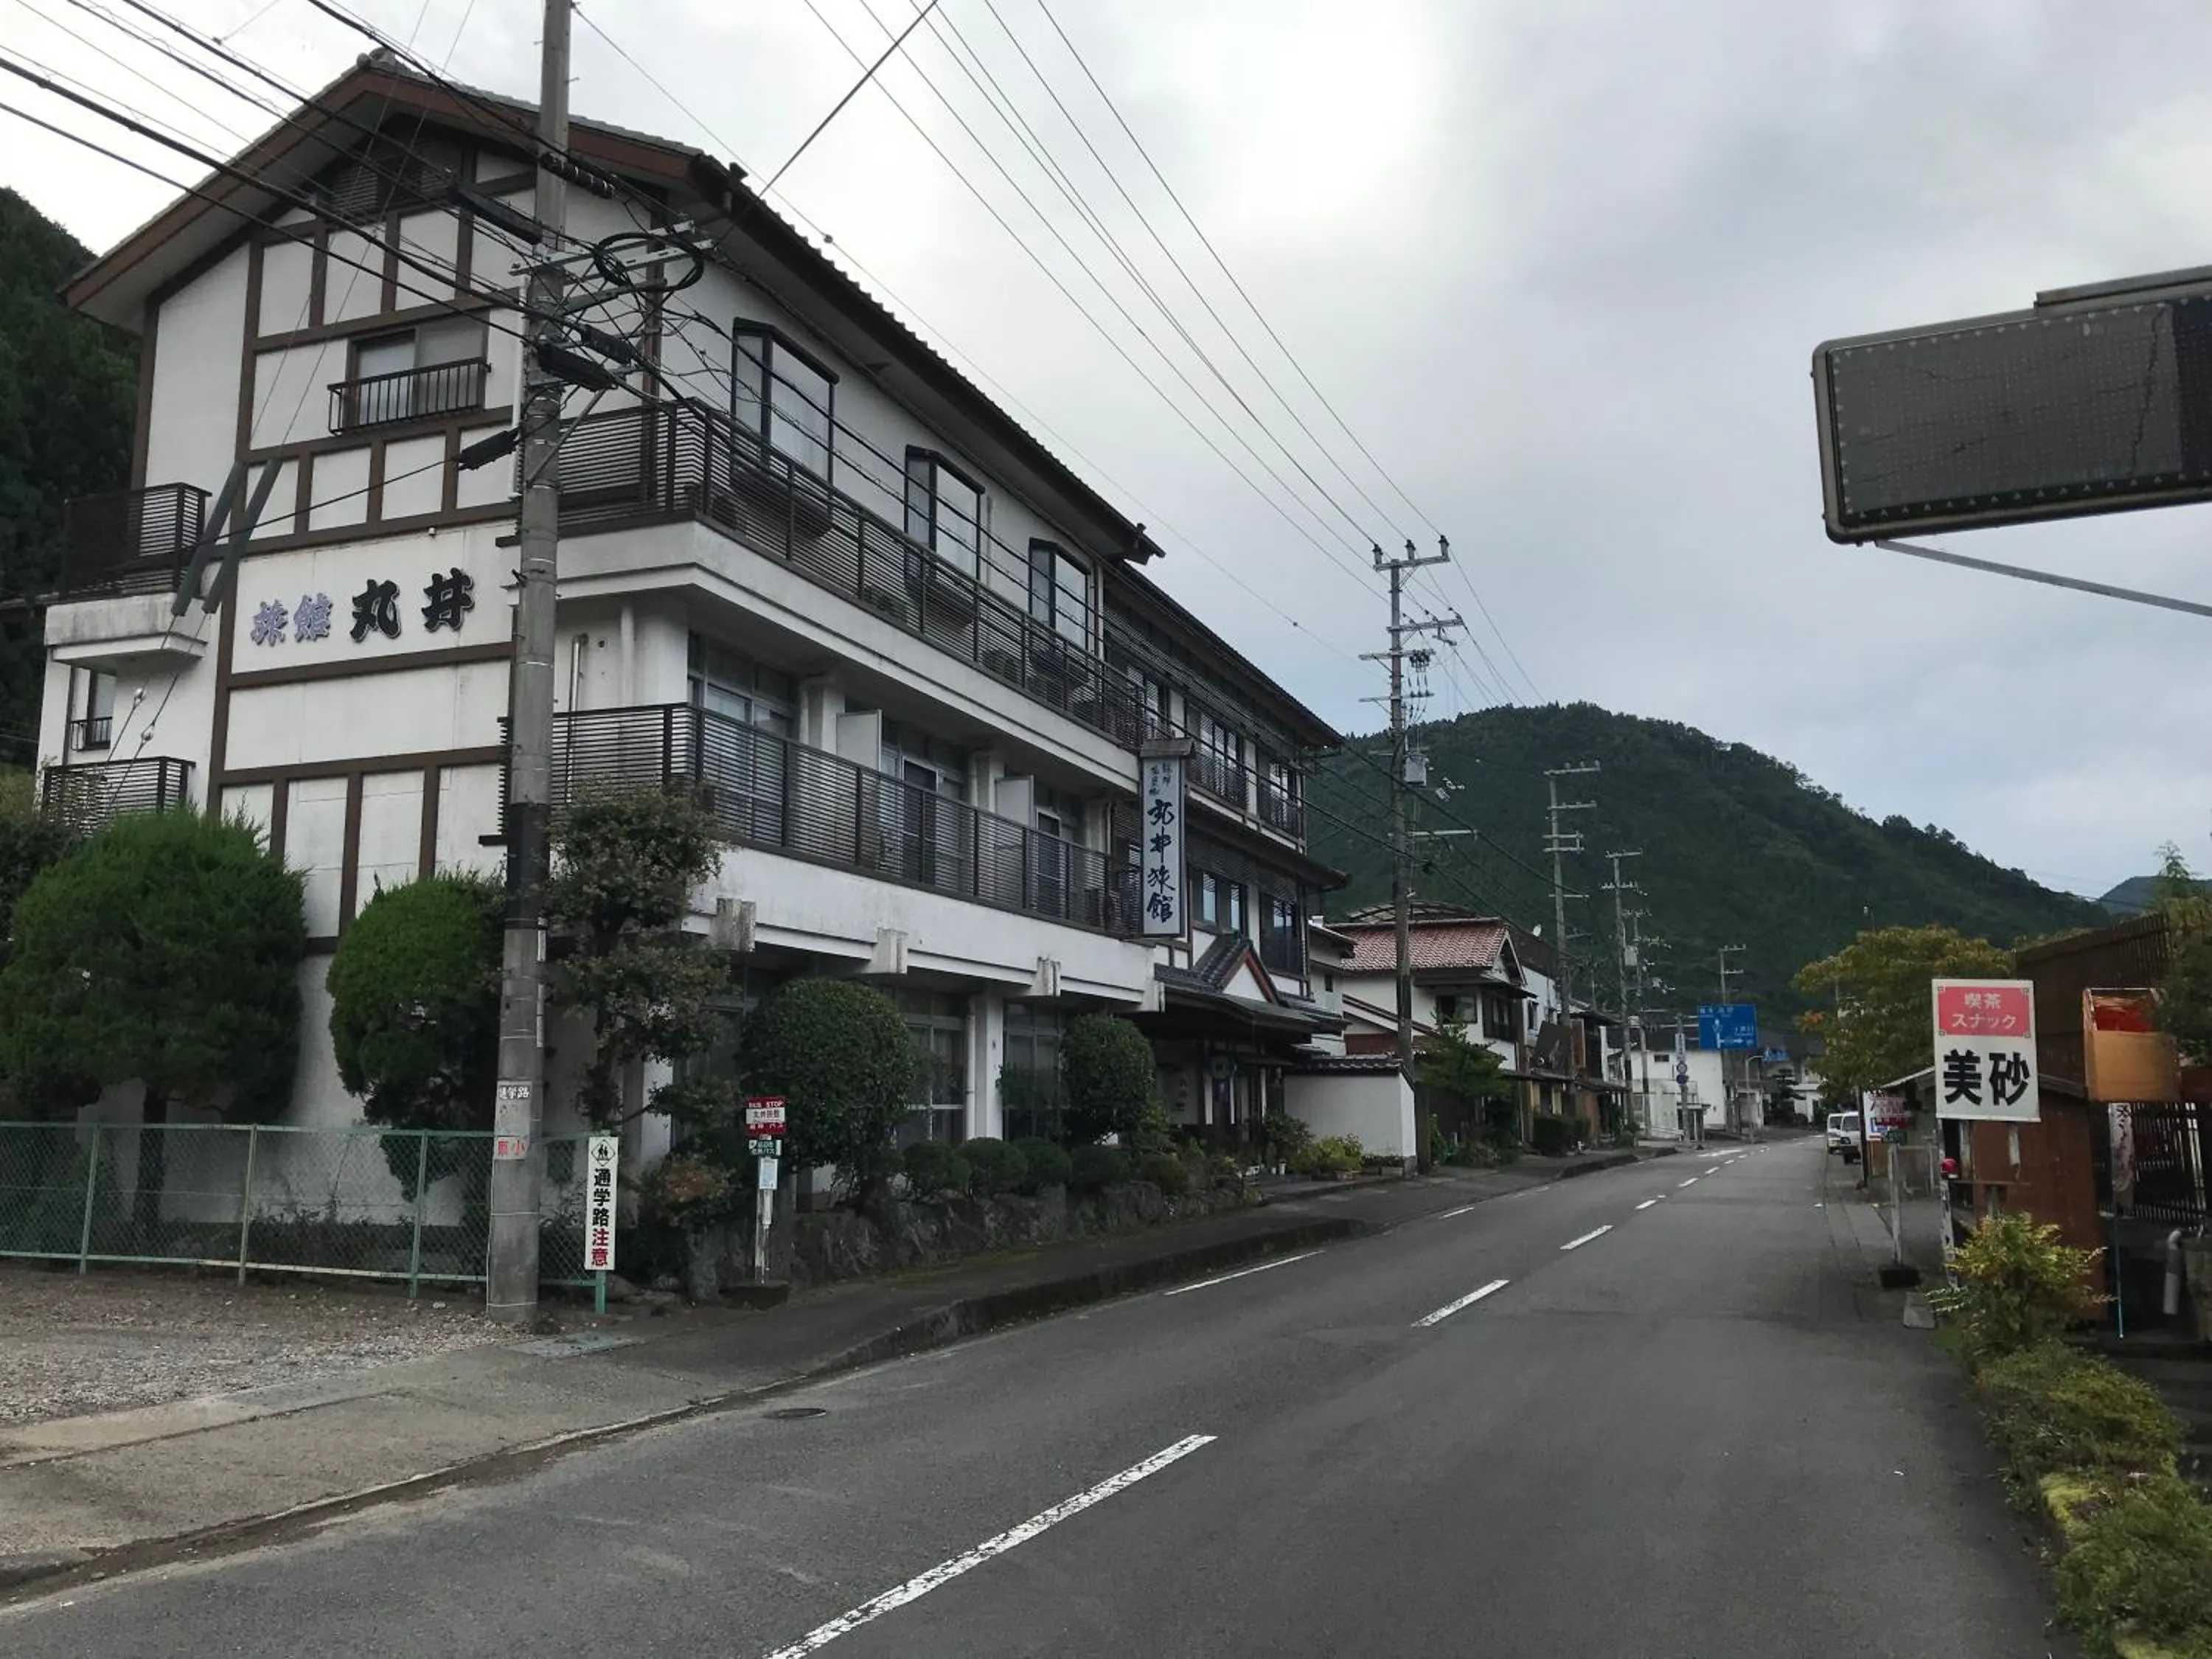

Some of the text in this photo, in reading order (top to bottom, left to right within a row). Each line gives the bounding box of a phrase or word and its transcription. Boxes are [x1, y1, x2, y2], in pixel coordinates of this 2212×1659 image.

[1964, 992, 2002, 1009] 喫茶
[1952, 1014, 2017, 1030] スナック
[1943, 1048, 2031, 1106] 美砂
[591, 1167, 611, 1267] 通学路注意
